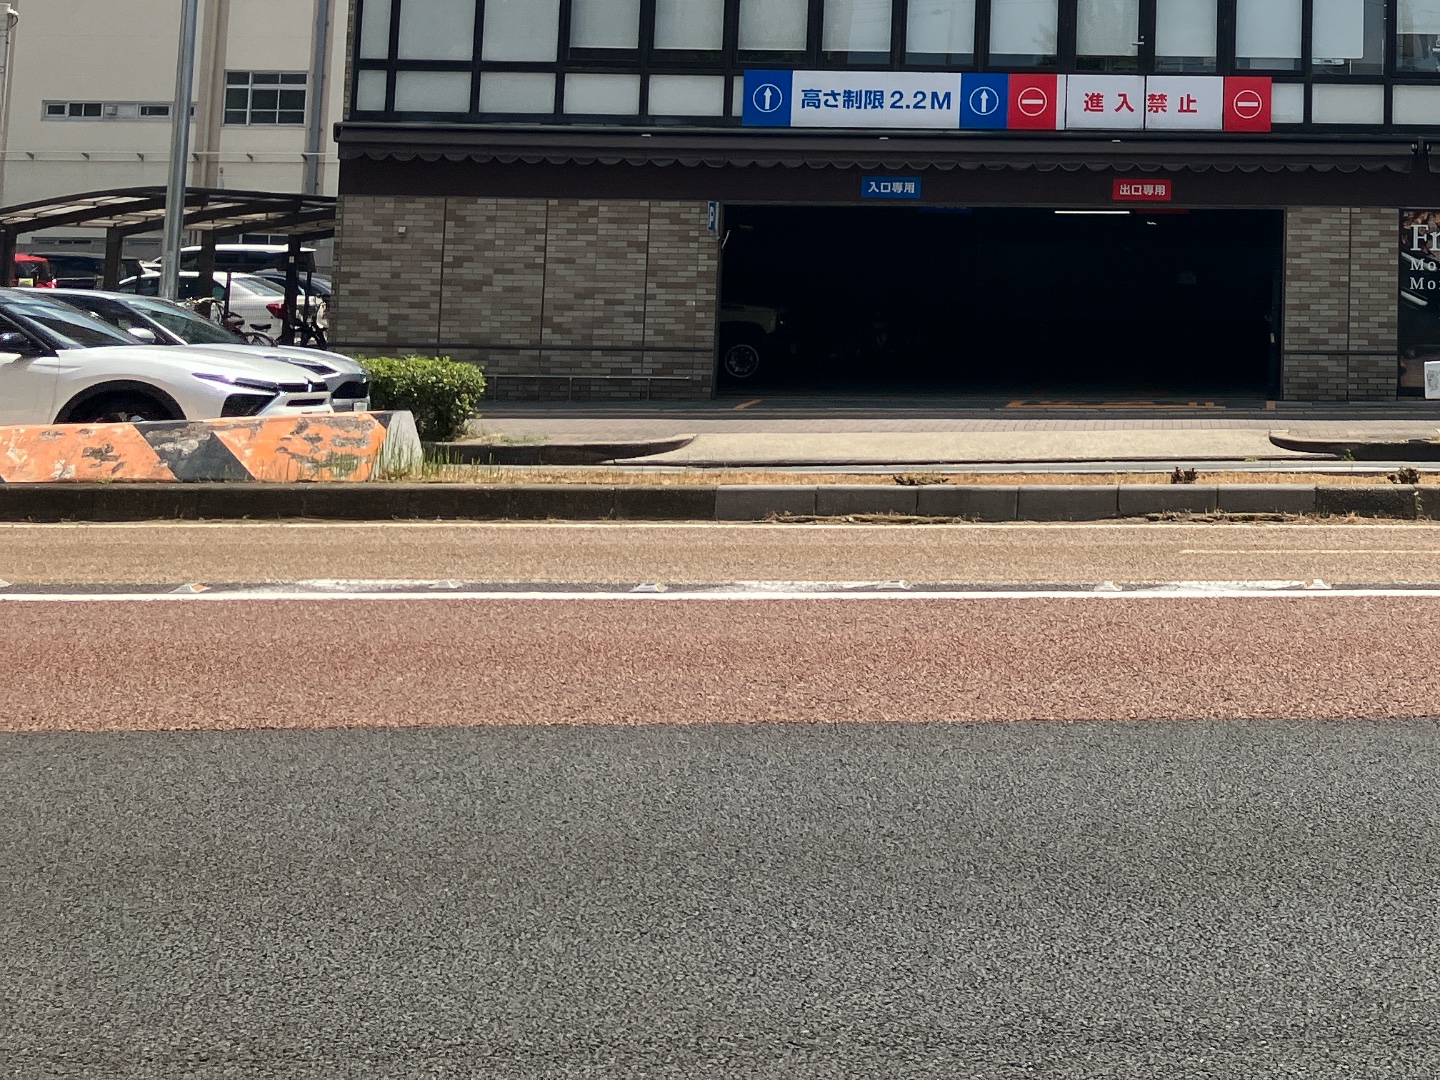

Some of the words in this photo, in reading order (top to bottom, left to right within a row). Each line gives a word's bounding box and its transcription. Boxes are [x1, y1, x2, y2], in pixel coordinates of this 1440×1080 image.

[800, 88, 885, 110] 高さ制限
[1083, 92, 1198, 114] 進入禁止
[868, 181, 915, 194] 入口専用
[1119, 183, 1166, 196] 出口専用
